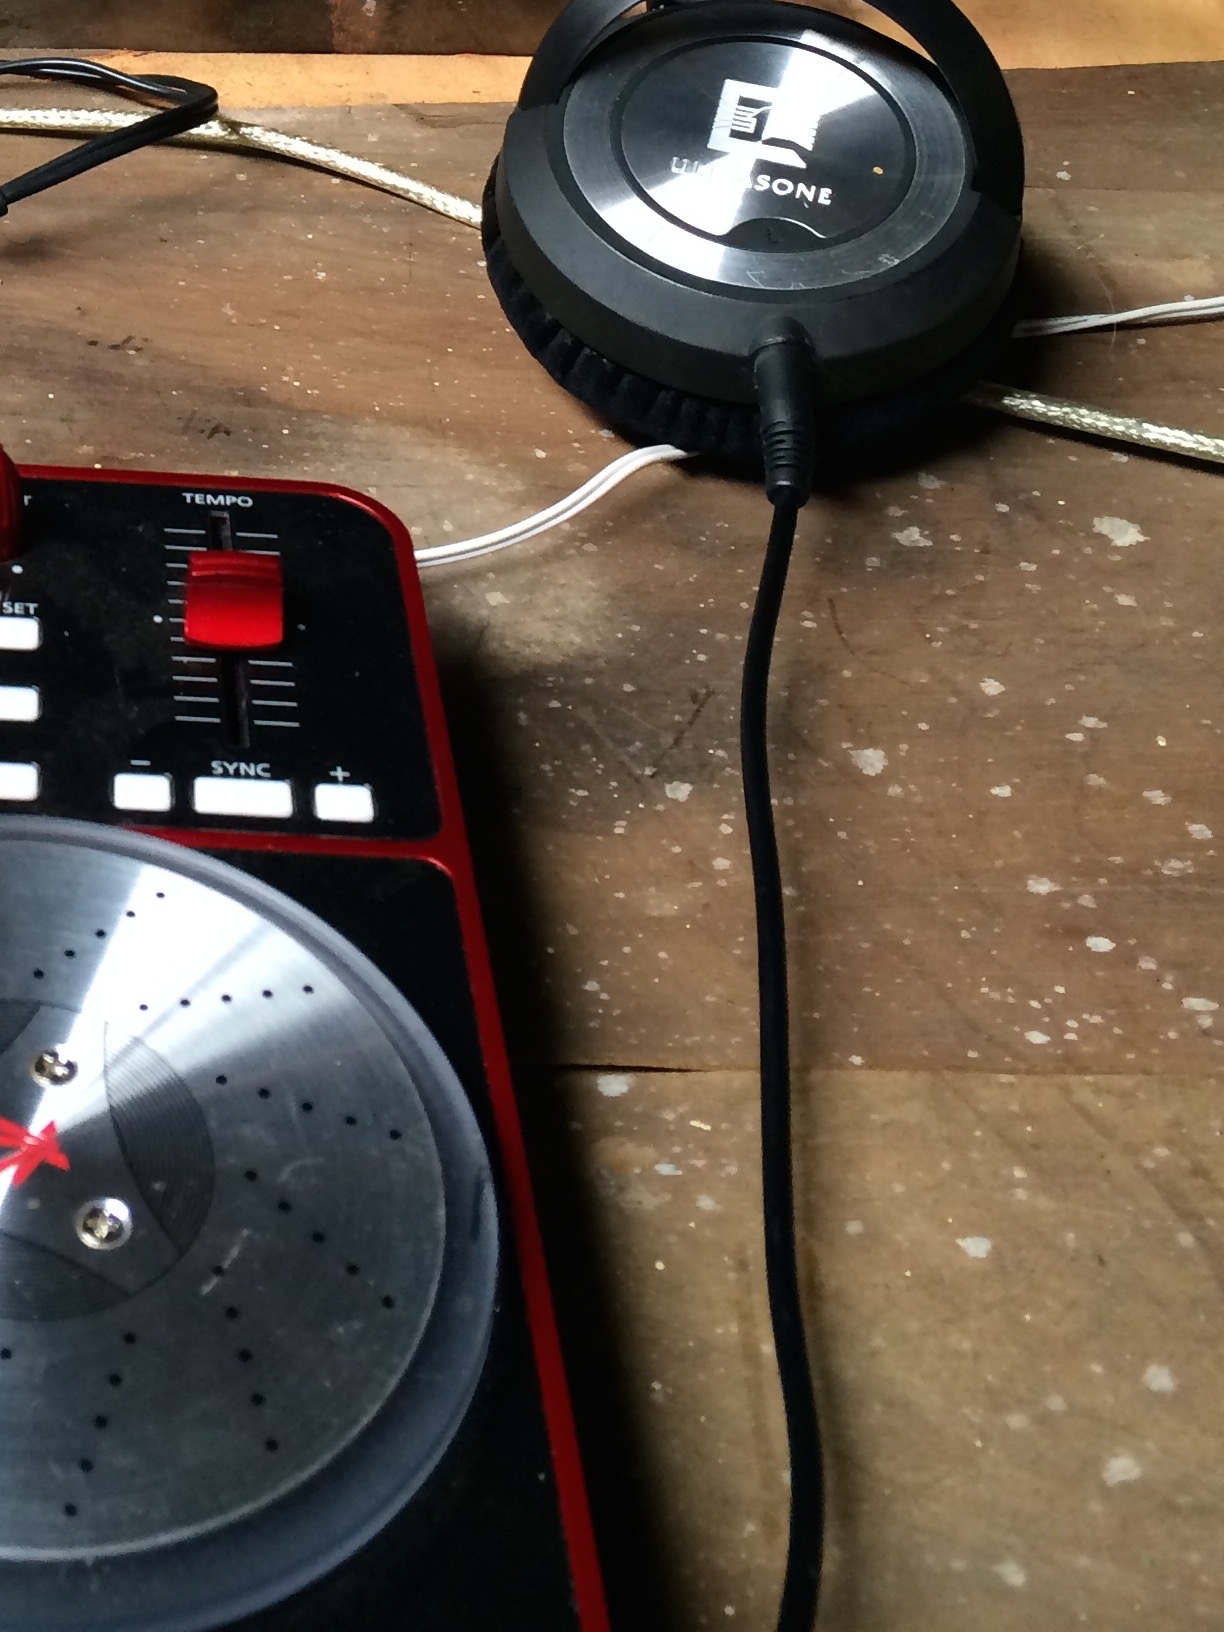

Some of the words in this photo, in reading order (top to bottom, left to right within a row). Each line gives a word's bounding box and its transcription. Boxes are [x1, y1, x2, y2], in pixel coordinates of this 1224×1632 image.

[182, 492, 253, 508] TEMPO
[2, 602, 38, 616] SET
[210, 761, 271, 778] SYNC
